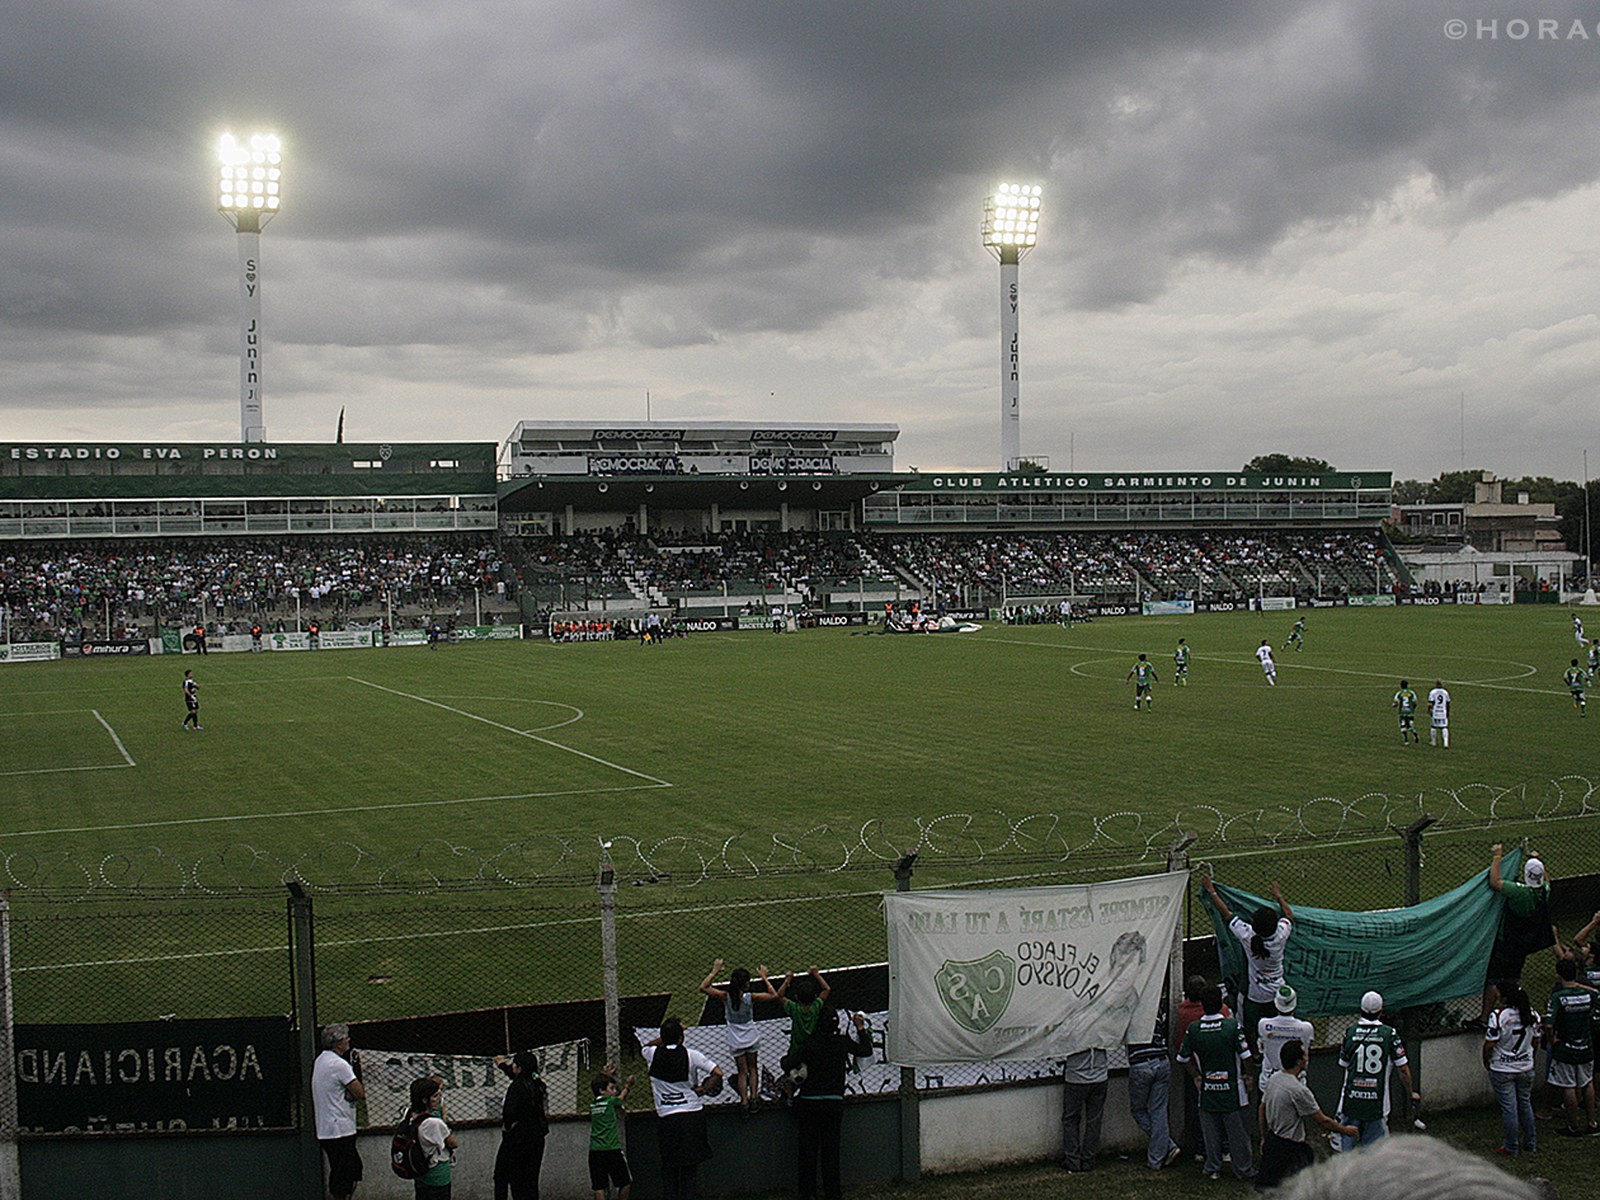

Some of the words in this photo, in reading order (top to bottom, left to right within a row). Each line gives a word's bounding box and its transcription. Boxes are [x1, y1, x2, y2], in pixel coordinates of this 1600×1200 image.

[595, 430, 681, 439] DEMOCRACIA
[753, 431, 833, 440] DEMOCRACIA
[11, 448, 120, 459] ESTADIO
[142, 448, 181, 459] EVA
[203, 448, 277, 459] PERON
[933, 477, 982, 487] CLUB
[998, 477, 1089, 487] ATLETICO
[1104, 477, 1212, 487] SARMIENTO
[1226, 477, 1247, 487] DE
[1262, 477, 1321, 487] JUNIN
[1415, 597, 1440, 605] NALDO
[1101, 606, 1126, 616] NALDO
[1210, 602, 1234, 611] NALDO
[819, 616, 847, 626] NALDO
[686, 621, 716, 632] NALDO
[93, 642, 129, 654] mihura
[1437, 694, 1443, 705] 9
[1511, 1027, 1527, 1054] 7
[1355, 1043, 1382, 1074] 18
